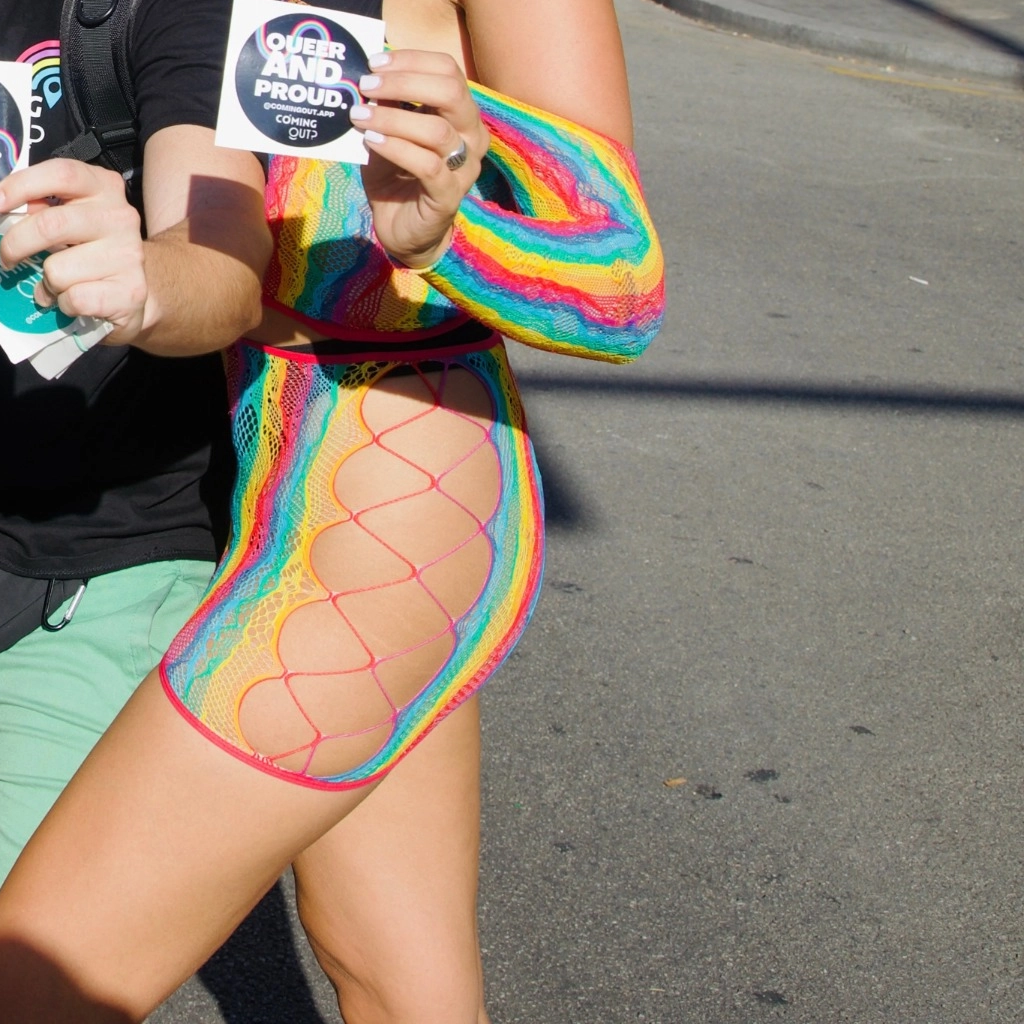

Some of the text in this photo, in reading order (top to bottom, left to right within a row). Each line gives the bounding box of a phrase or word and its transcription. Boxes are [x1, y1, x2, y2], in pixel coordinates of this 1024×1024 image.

[266, 33, 347, 61] QUEER
[261, 51, 343, 85] AND
[254, 78, 348, 110] PROUD.
[263, 102, 335, 118] @COMINGOUT.APP
